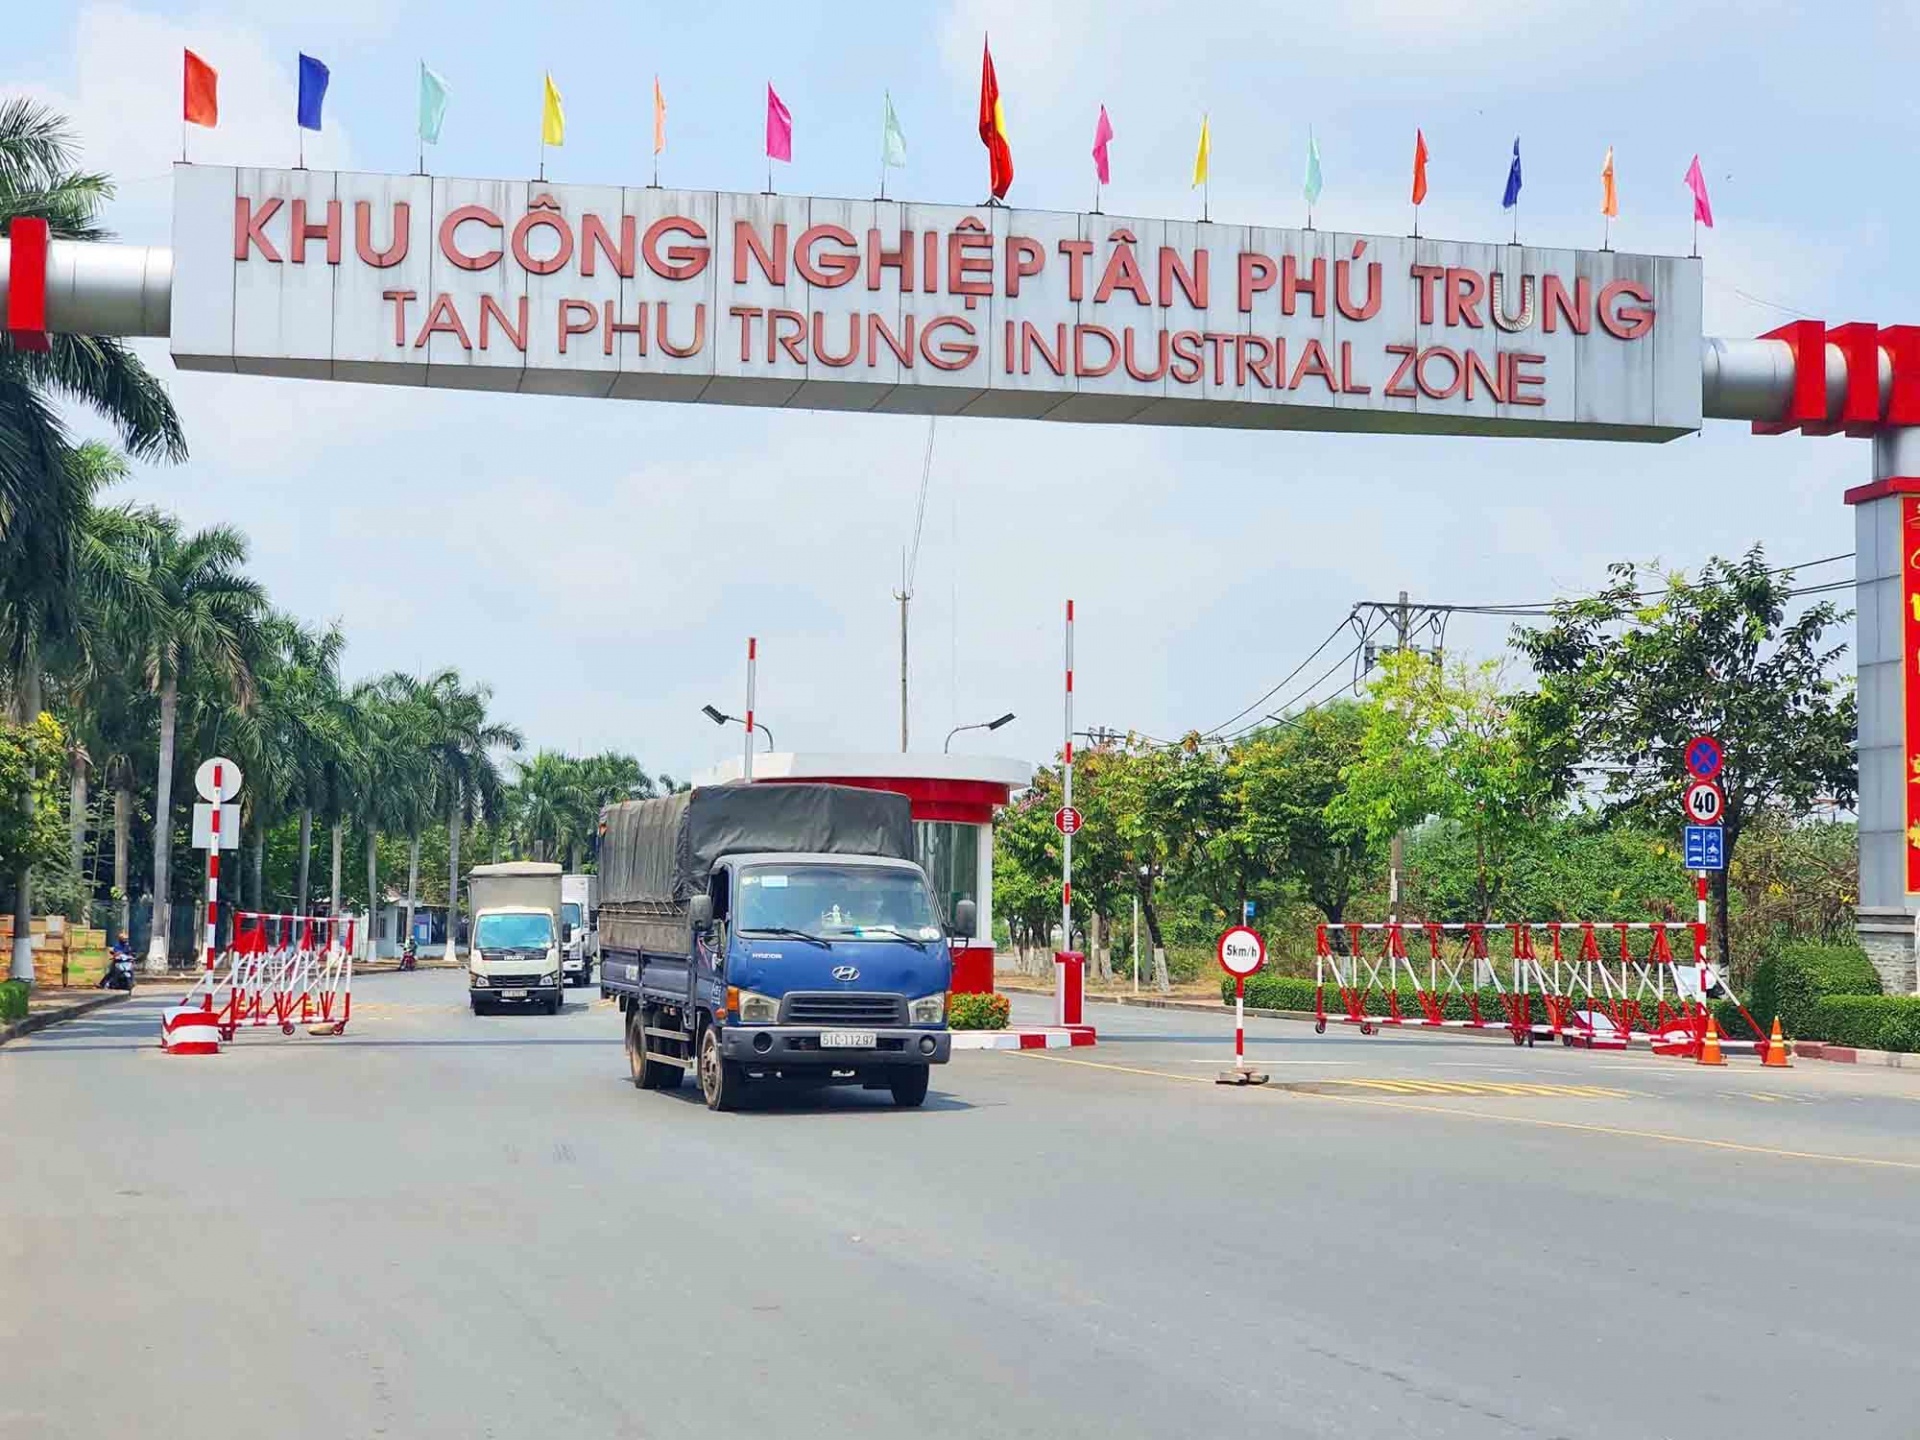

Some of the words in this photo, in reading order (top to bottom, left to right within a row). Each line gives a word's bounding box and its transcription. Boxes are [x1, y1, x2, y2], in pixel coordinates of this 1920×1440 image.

[234, 195, 410, 268] KHU
[438, 193, 711, 281] CÔNG
[733, 215, 1046, 310] NGHIỆP
[1058, 228, 1209, 309] TÂN
[1236, 239, 1383, 321] PHÚ
[1411, 264, 1656, 341] TRUNG
[382, 290, 528, 352] TAN
[558, 298, 706, 358] PHU
[729, 306, 979, 371] TRUNG
[1005, 320, 1371, 395] INDUSTRIAL
[1383, 343, 1546, 405] ZONE
[1693, 791, 1716, 813] 40
[1063, 808, 1075, 832] STOP
[1226, 944, 1257, 958] 5km/h
